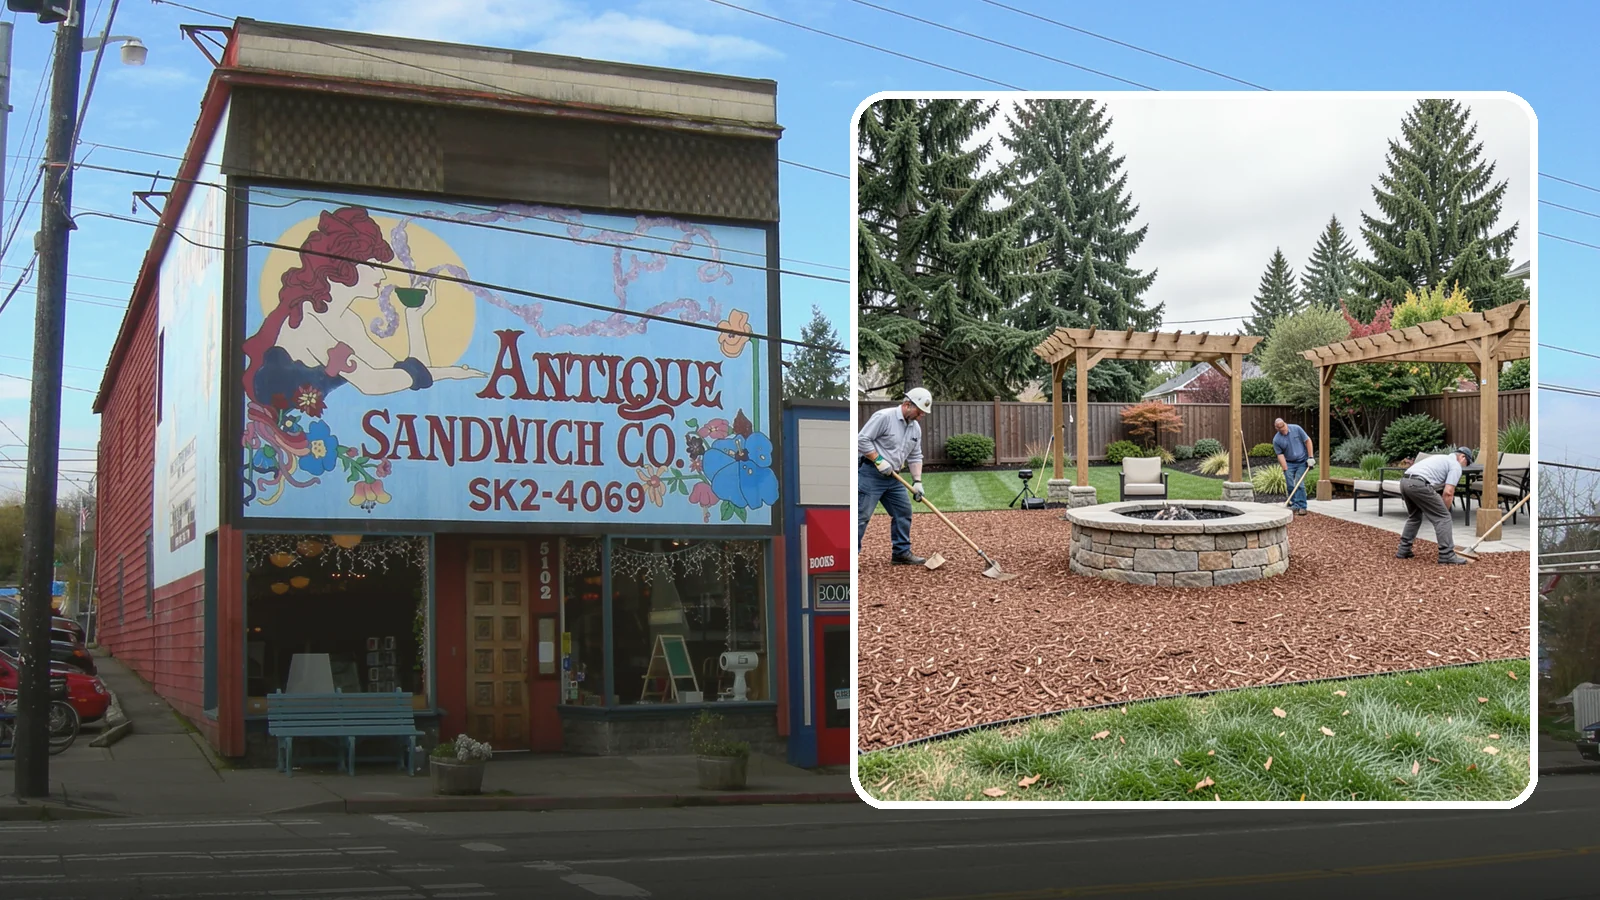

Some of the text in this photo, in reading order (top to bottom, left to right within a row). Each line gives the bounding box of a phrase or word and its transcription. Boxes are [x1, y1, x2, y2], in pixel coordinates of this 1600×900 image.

[476, 329, 723, 421] ANTIQUE
[361, 408, 685, 470] SANDWICH CO.
[468, 477, 645, 513] SK2-4069
[540, 542, 552, 599] 5102
[810, 556, 835, 569] BOOKS
